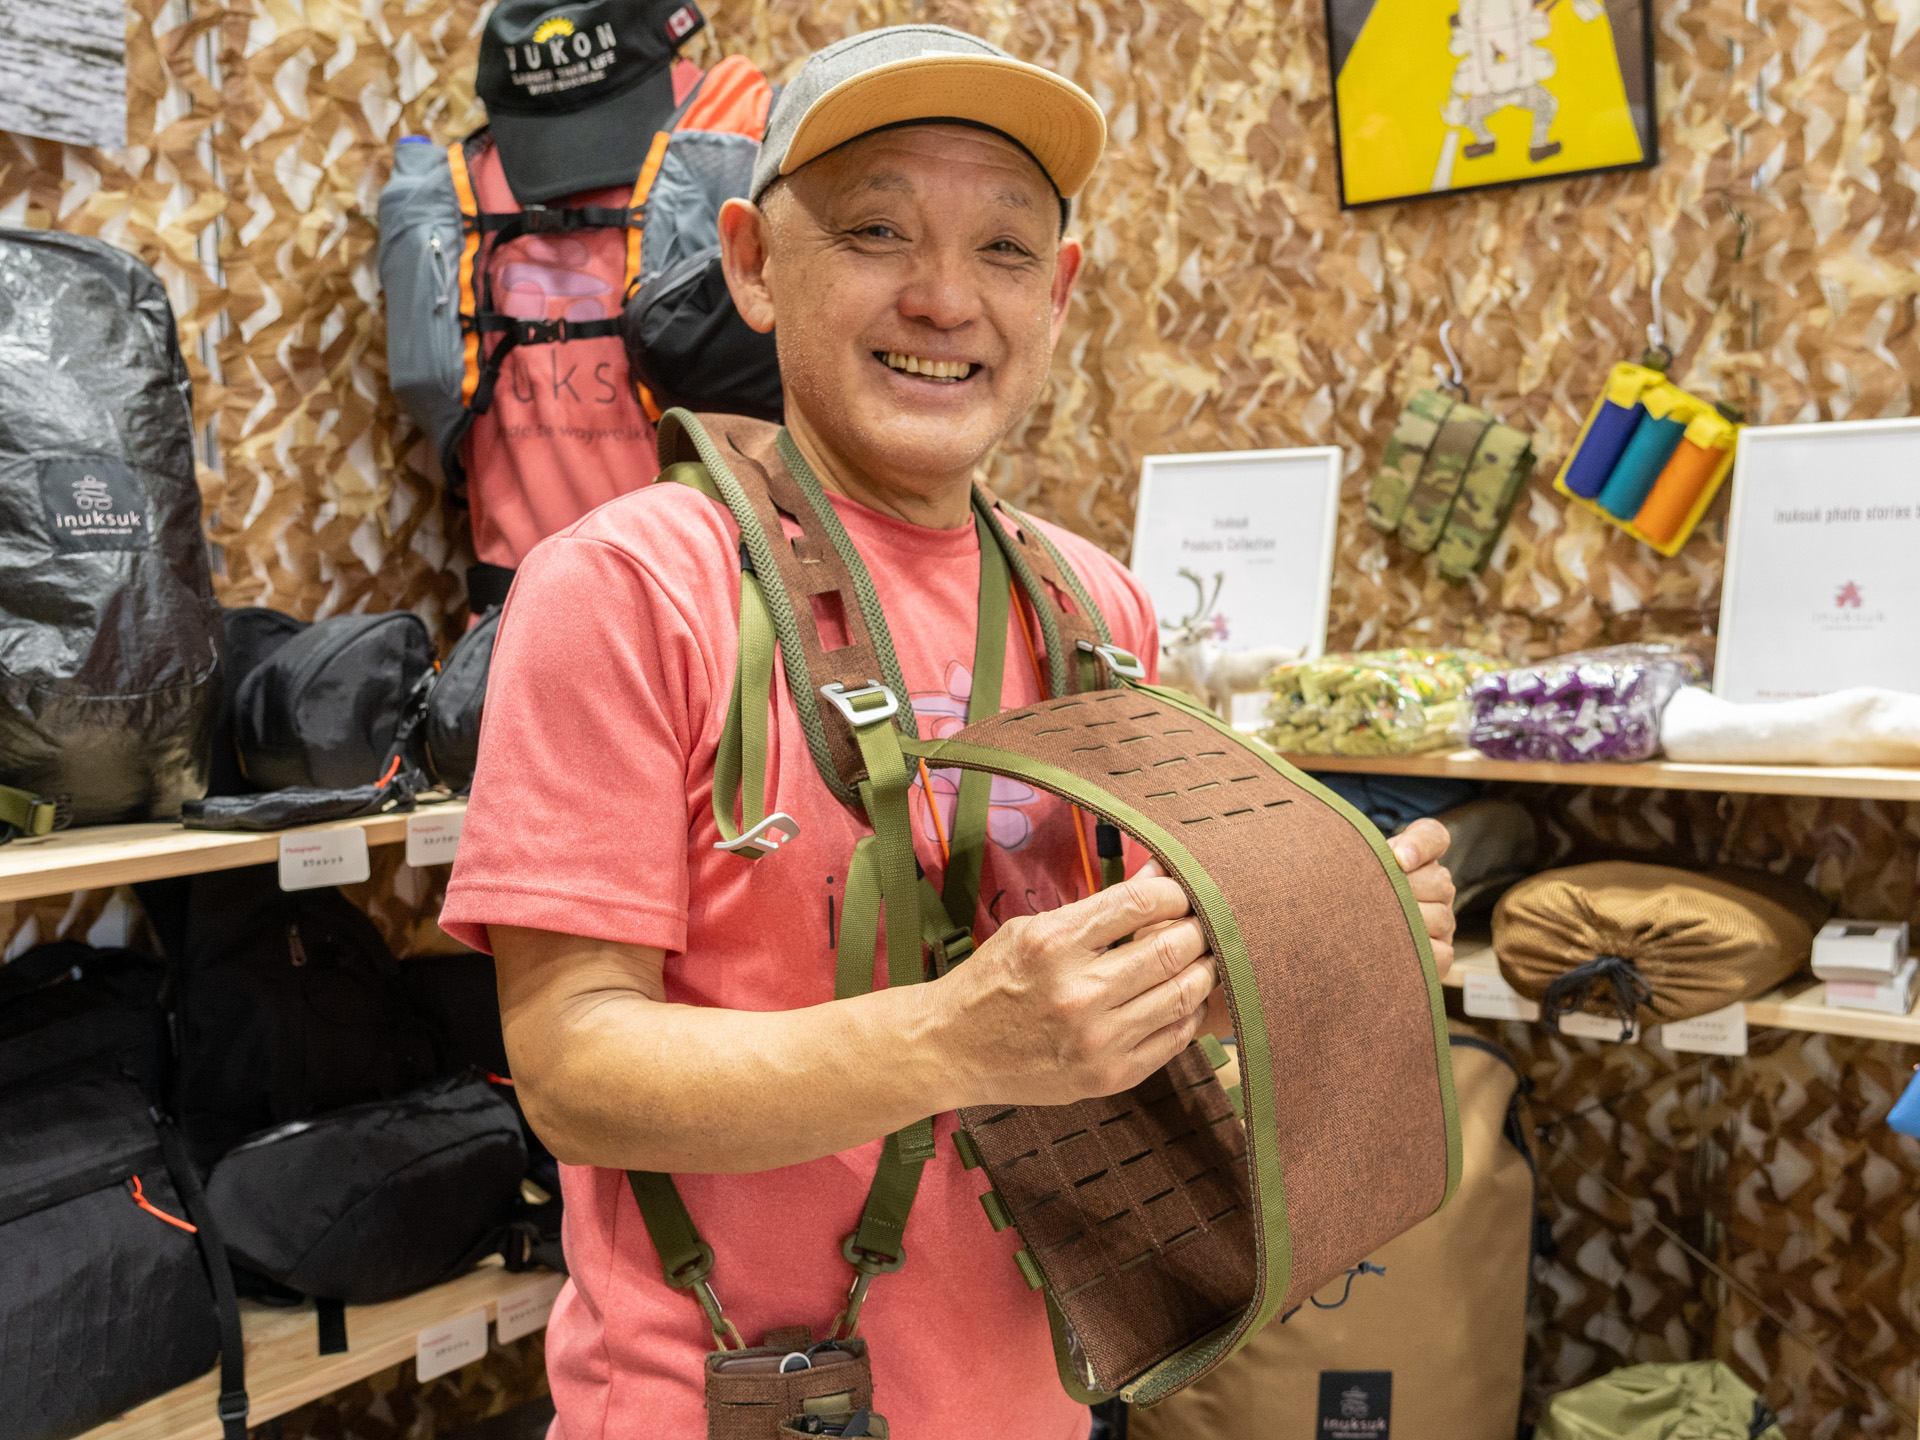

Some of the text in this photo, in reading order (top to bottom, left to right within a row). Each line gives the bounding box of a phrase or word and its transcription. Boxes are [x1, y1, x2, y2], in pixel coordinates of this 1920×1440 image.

[504, 22, 617, 71] YUKON
[56, 509, 141, 528] inuksuk
[1824, 504, 1861, 526] photo
[1866, 501, 1911, 520] stories
[1322, 1415, 1387, 1432] inuksuk
